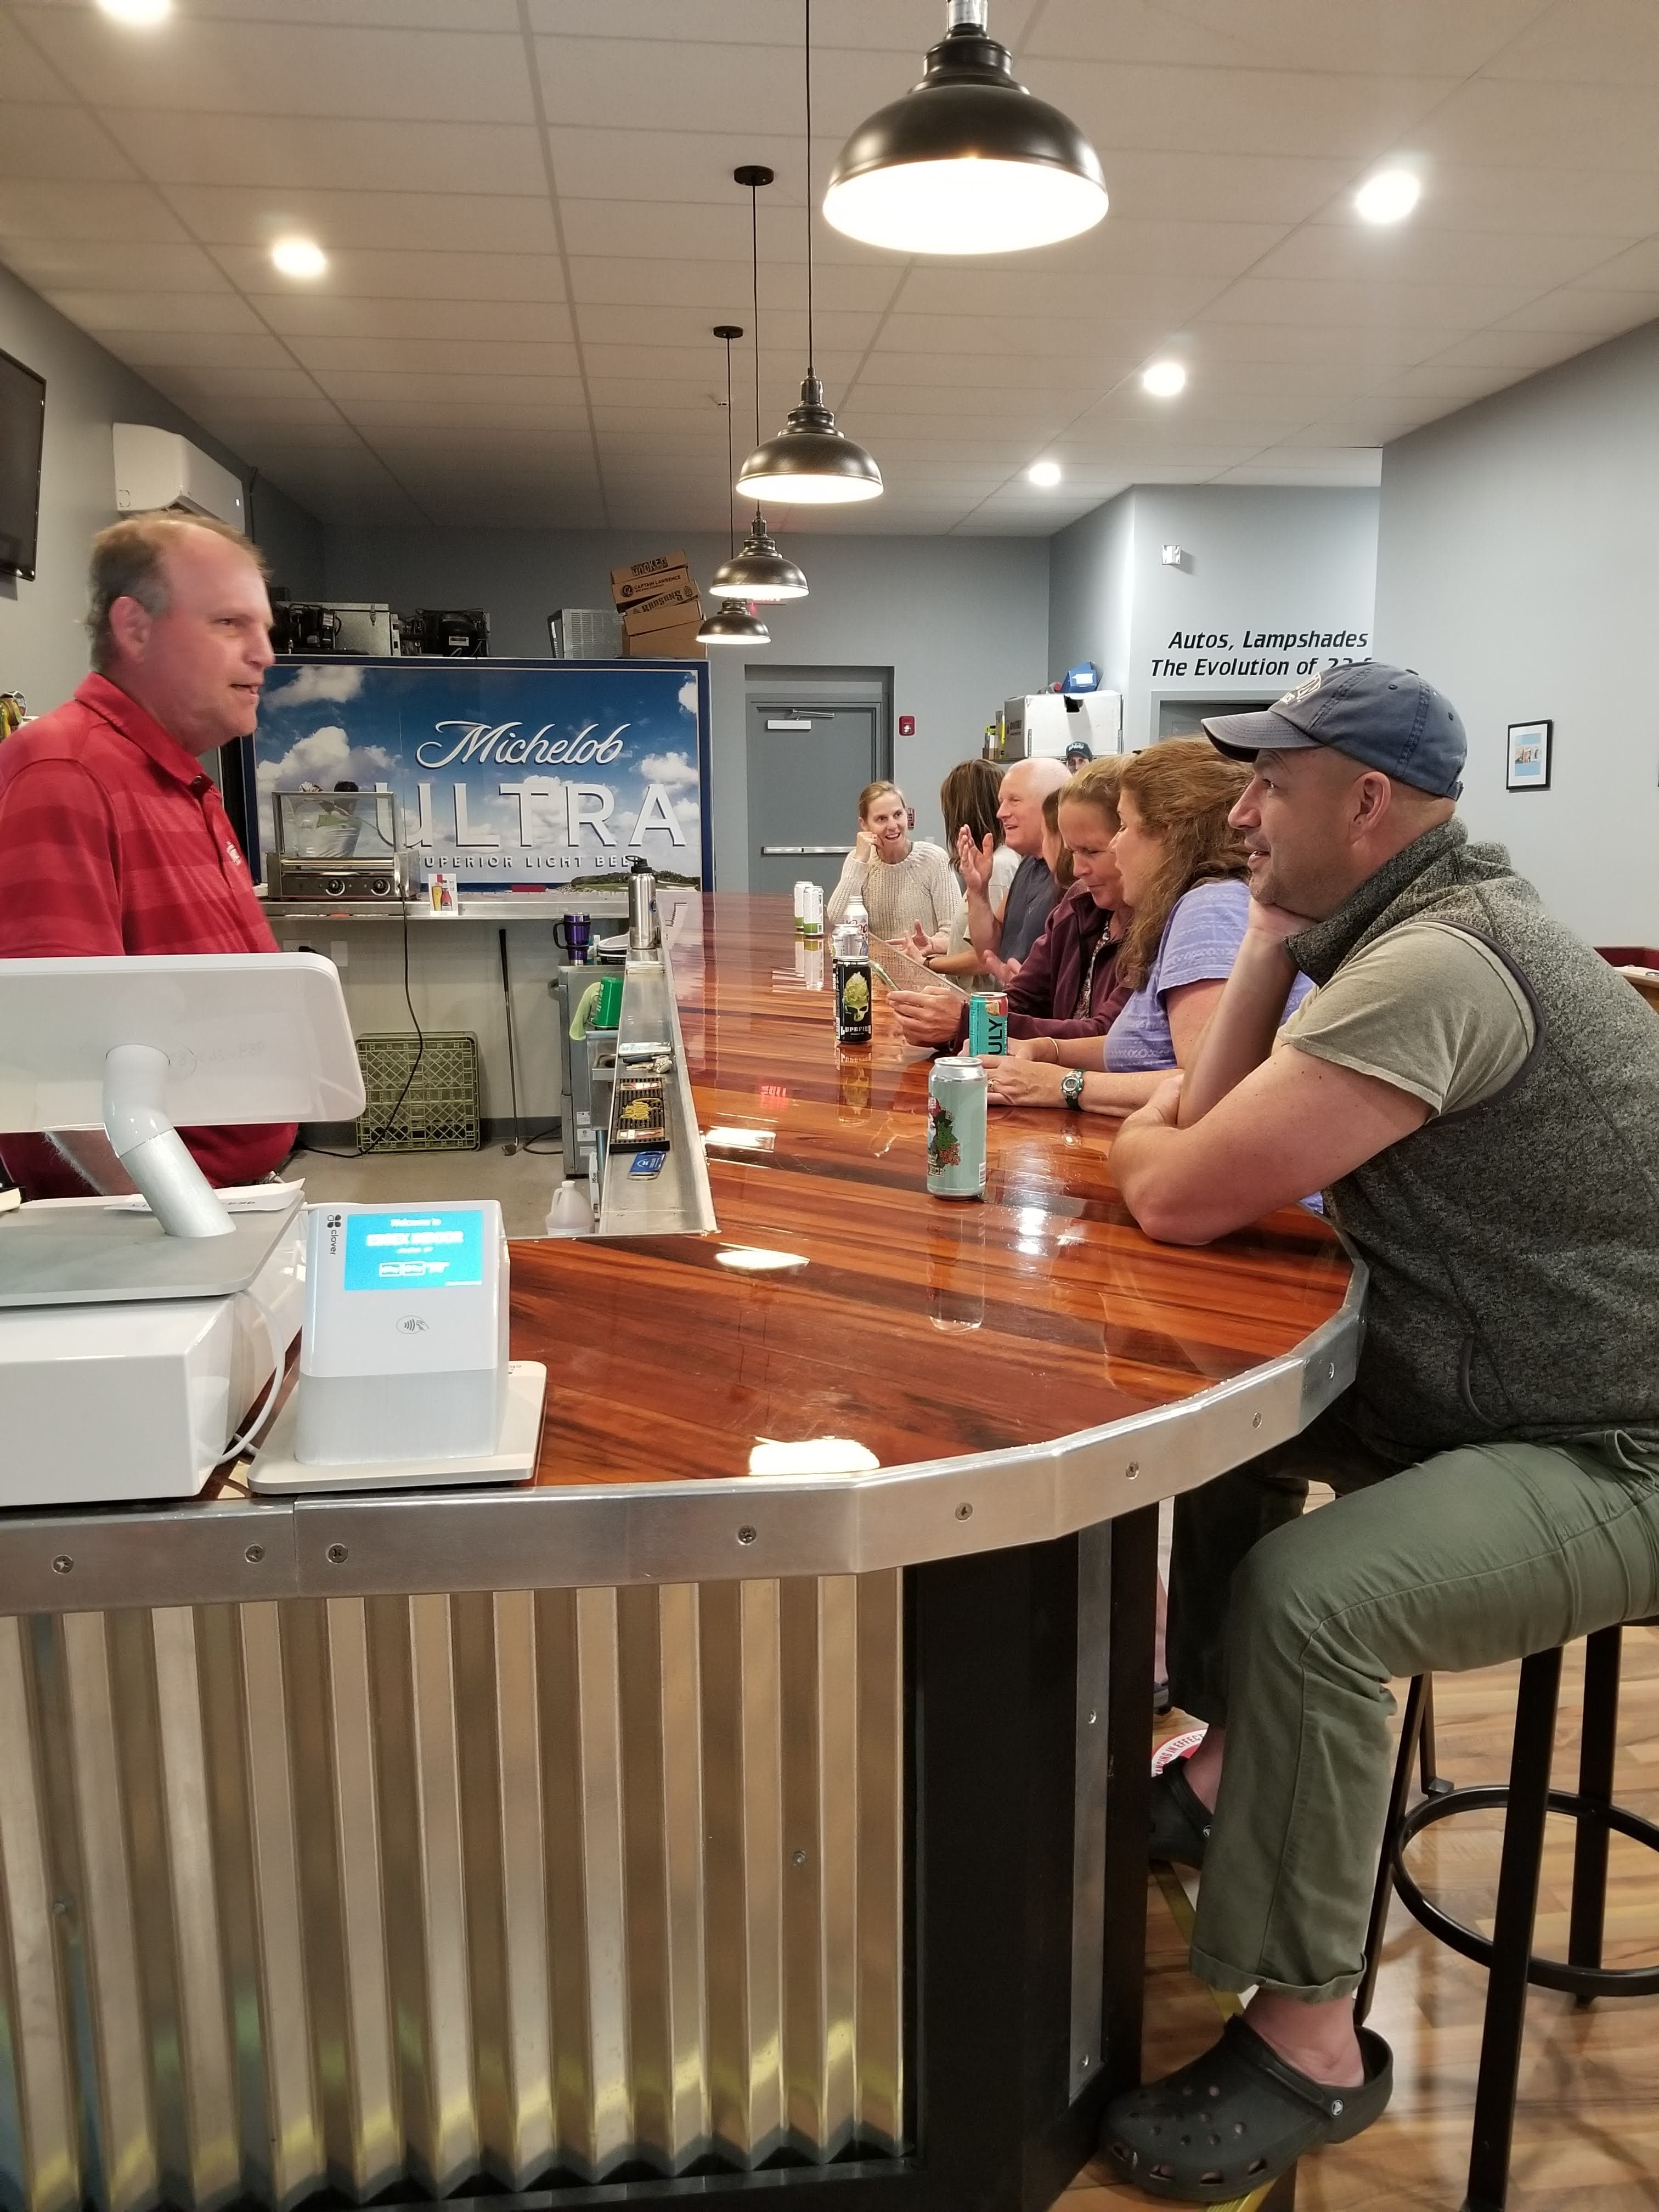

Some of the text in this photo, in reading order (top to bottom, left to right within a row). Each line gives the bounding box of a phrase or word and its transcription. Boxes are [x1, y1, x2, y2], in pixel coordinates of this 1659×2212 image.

[1168, 630, 1369, 651] Autos, Lampshades
[1152, 659, 1187, 676] The
[1194, 658, 1290, 676] Evolution
[1296, 658, 1319, 675] of
[416, 720, 631, 769] Michelob
[374, 782, 686, 848] ULTRA
[424, 855, 629, 868] UPERIOR LIGHT BEE
[988, 1018, 1003, 1054] ULY
[330, 1229, 340, 1255] clover
[1173, 1733, 1204, 1748] EFFECT
